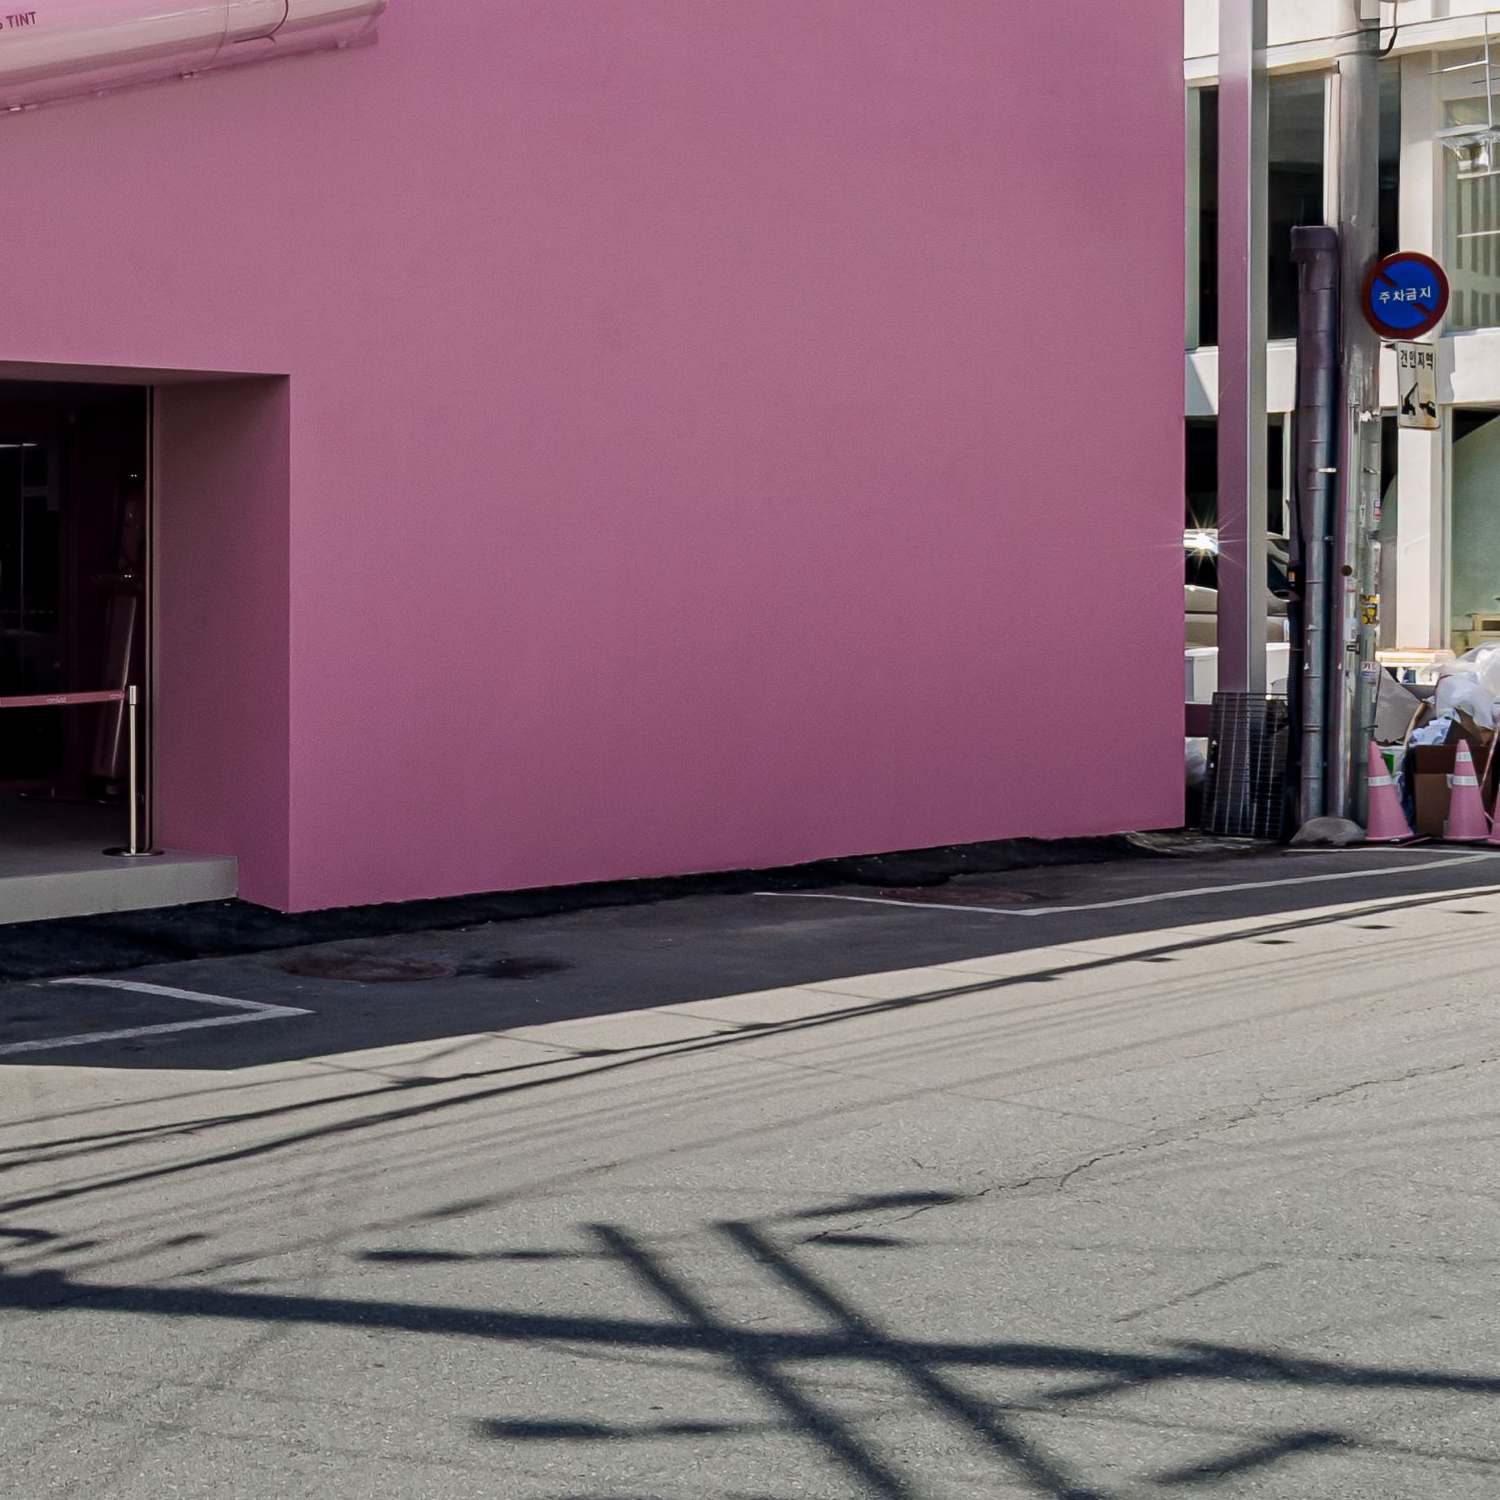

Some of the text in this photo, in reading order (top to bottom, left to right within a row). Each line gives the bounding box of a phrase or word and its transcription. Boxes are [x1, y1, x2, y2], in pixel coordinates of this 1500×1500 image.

[6, 11, 37, 29] TINT
[1379, 285, 1432, 304] 주차금지
[1400, 349, 1434, 370] 견인지역
